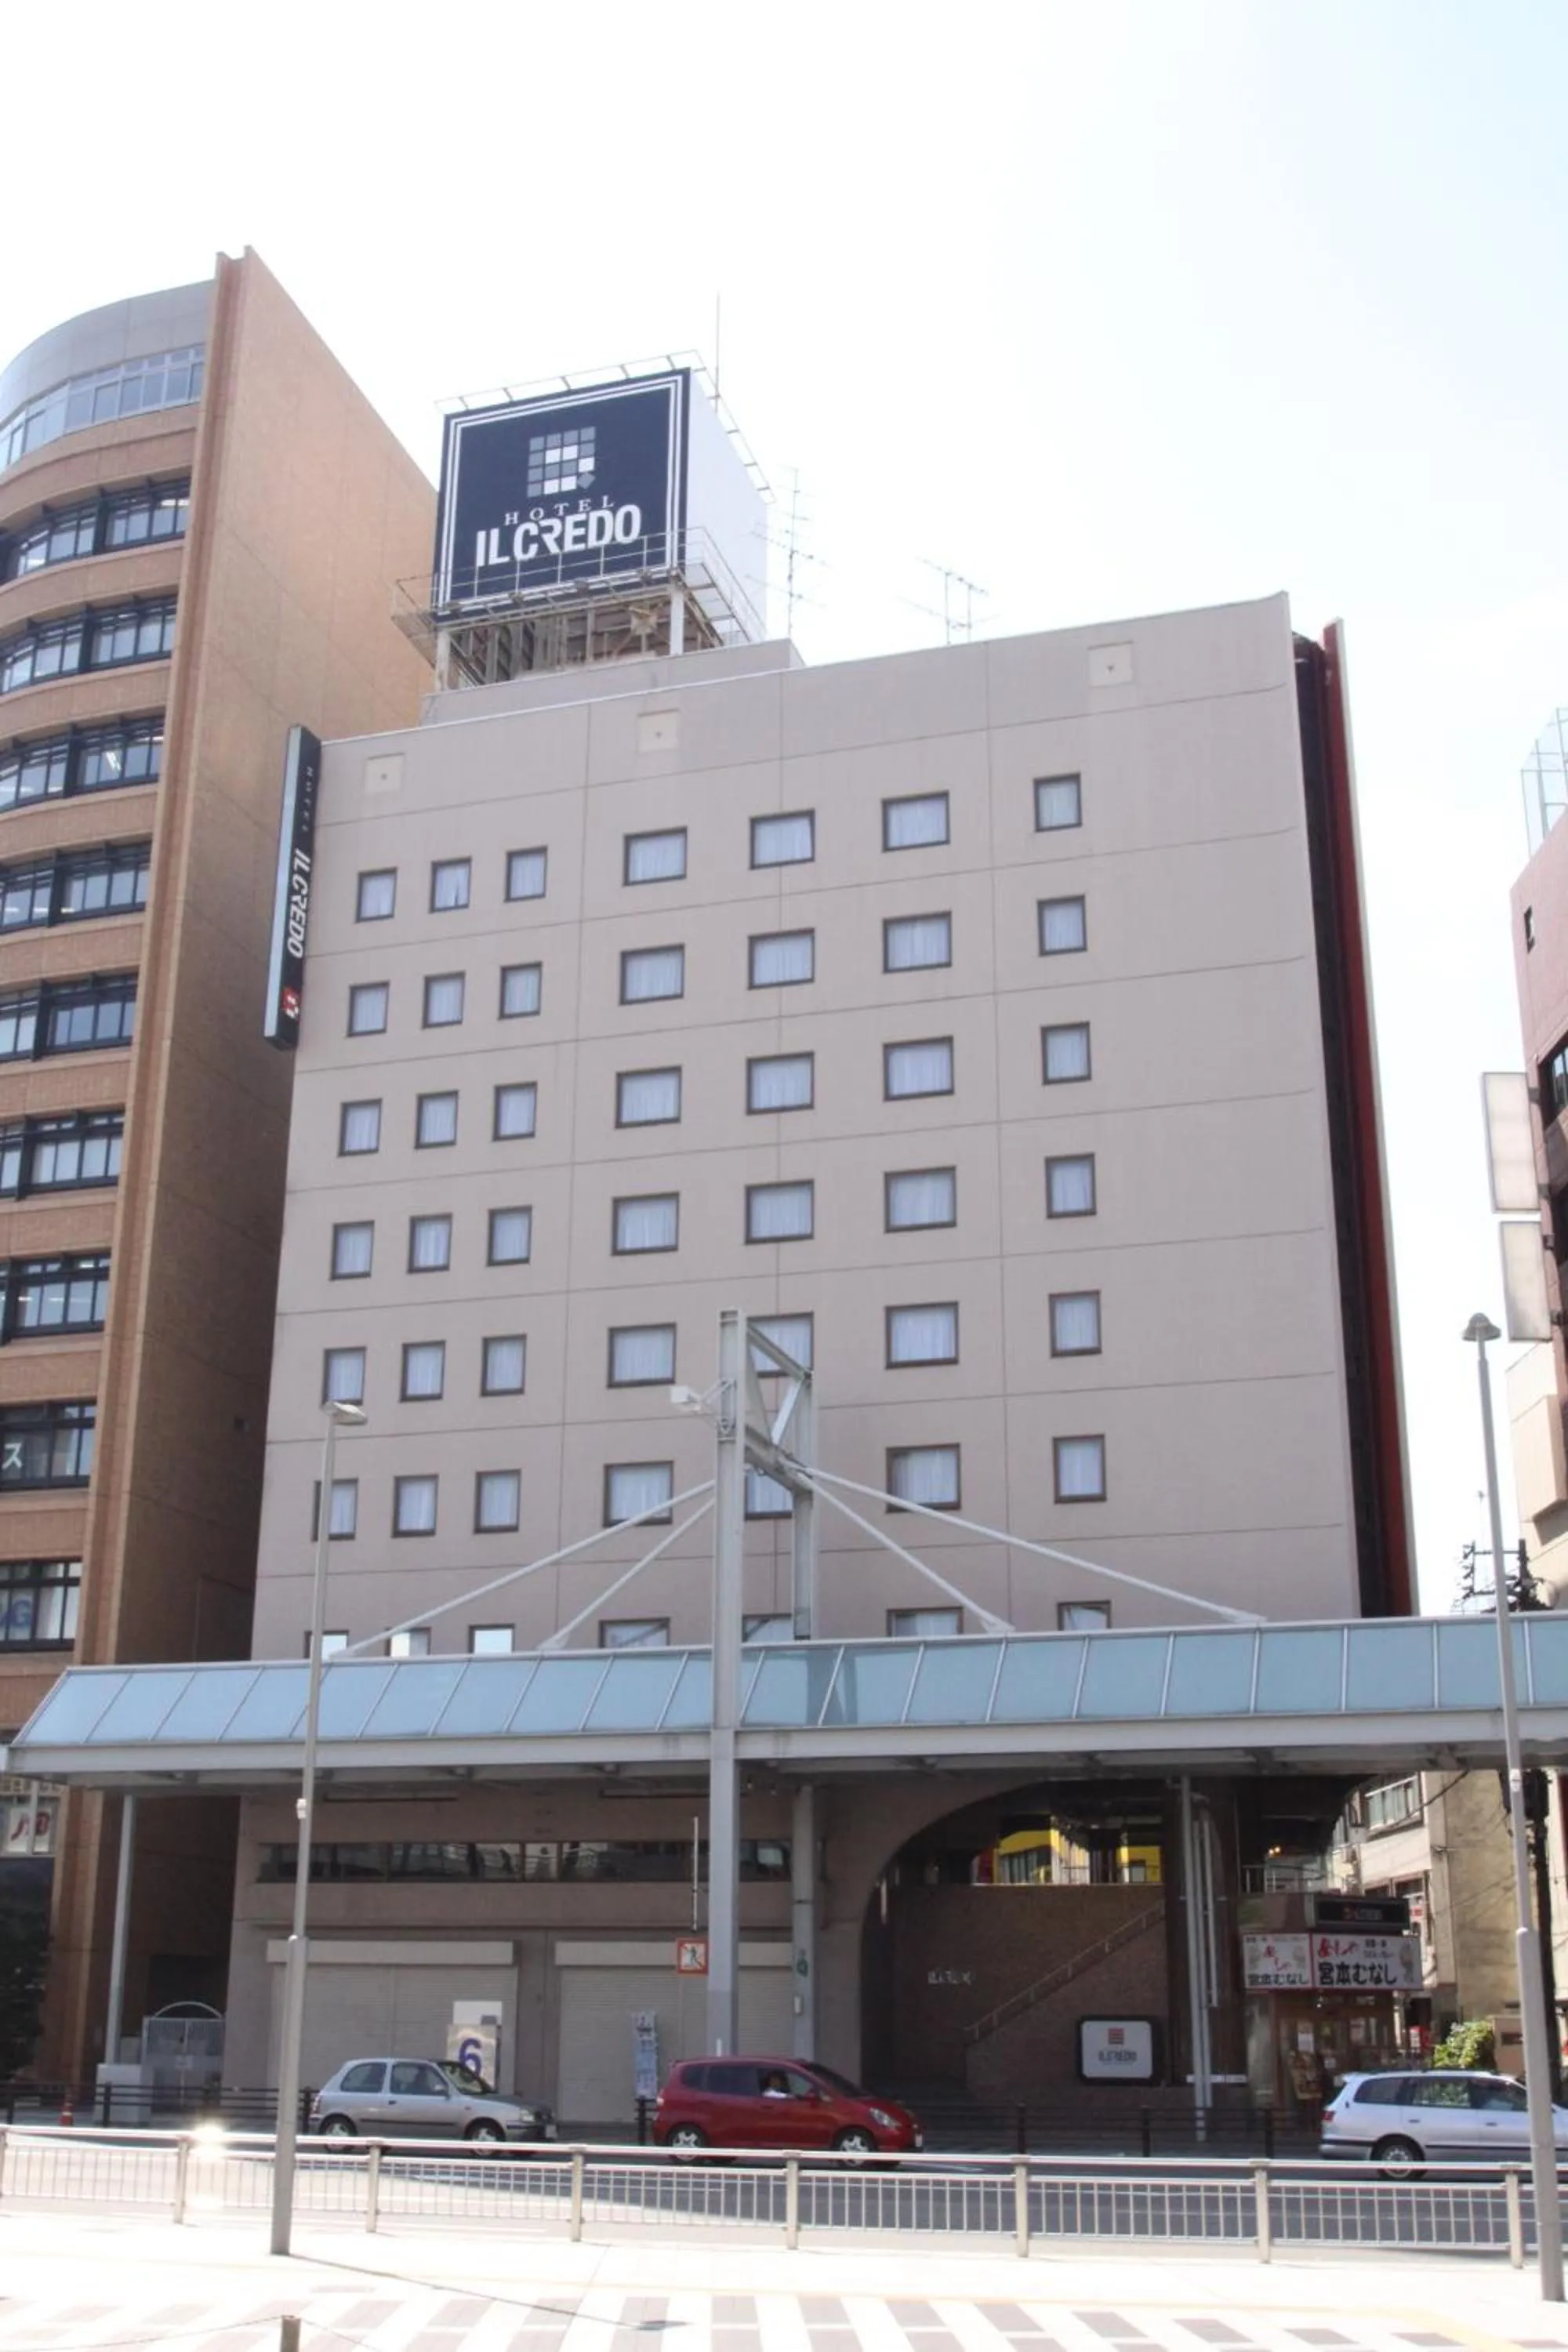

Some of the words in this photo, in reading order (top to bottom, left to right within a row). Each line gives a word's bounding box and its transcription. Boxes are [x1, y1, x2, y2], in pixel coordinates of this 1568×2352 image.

[504, 495, 615, 526] HOTEL
[2, 1443, 23, 1469] ス
[1319, 1962, 1397, 1985] 宮本むなし
[459, 2038, 482, 2079] 6
